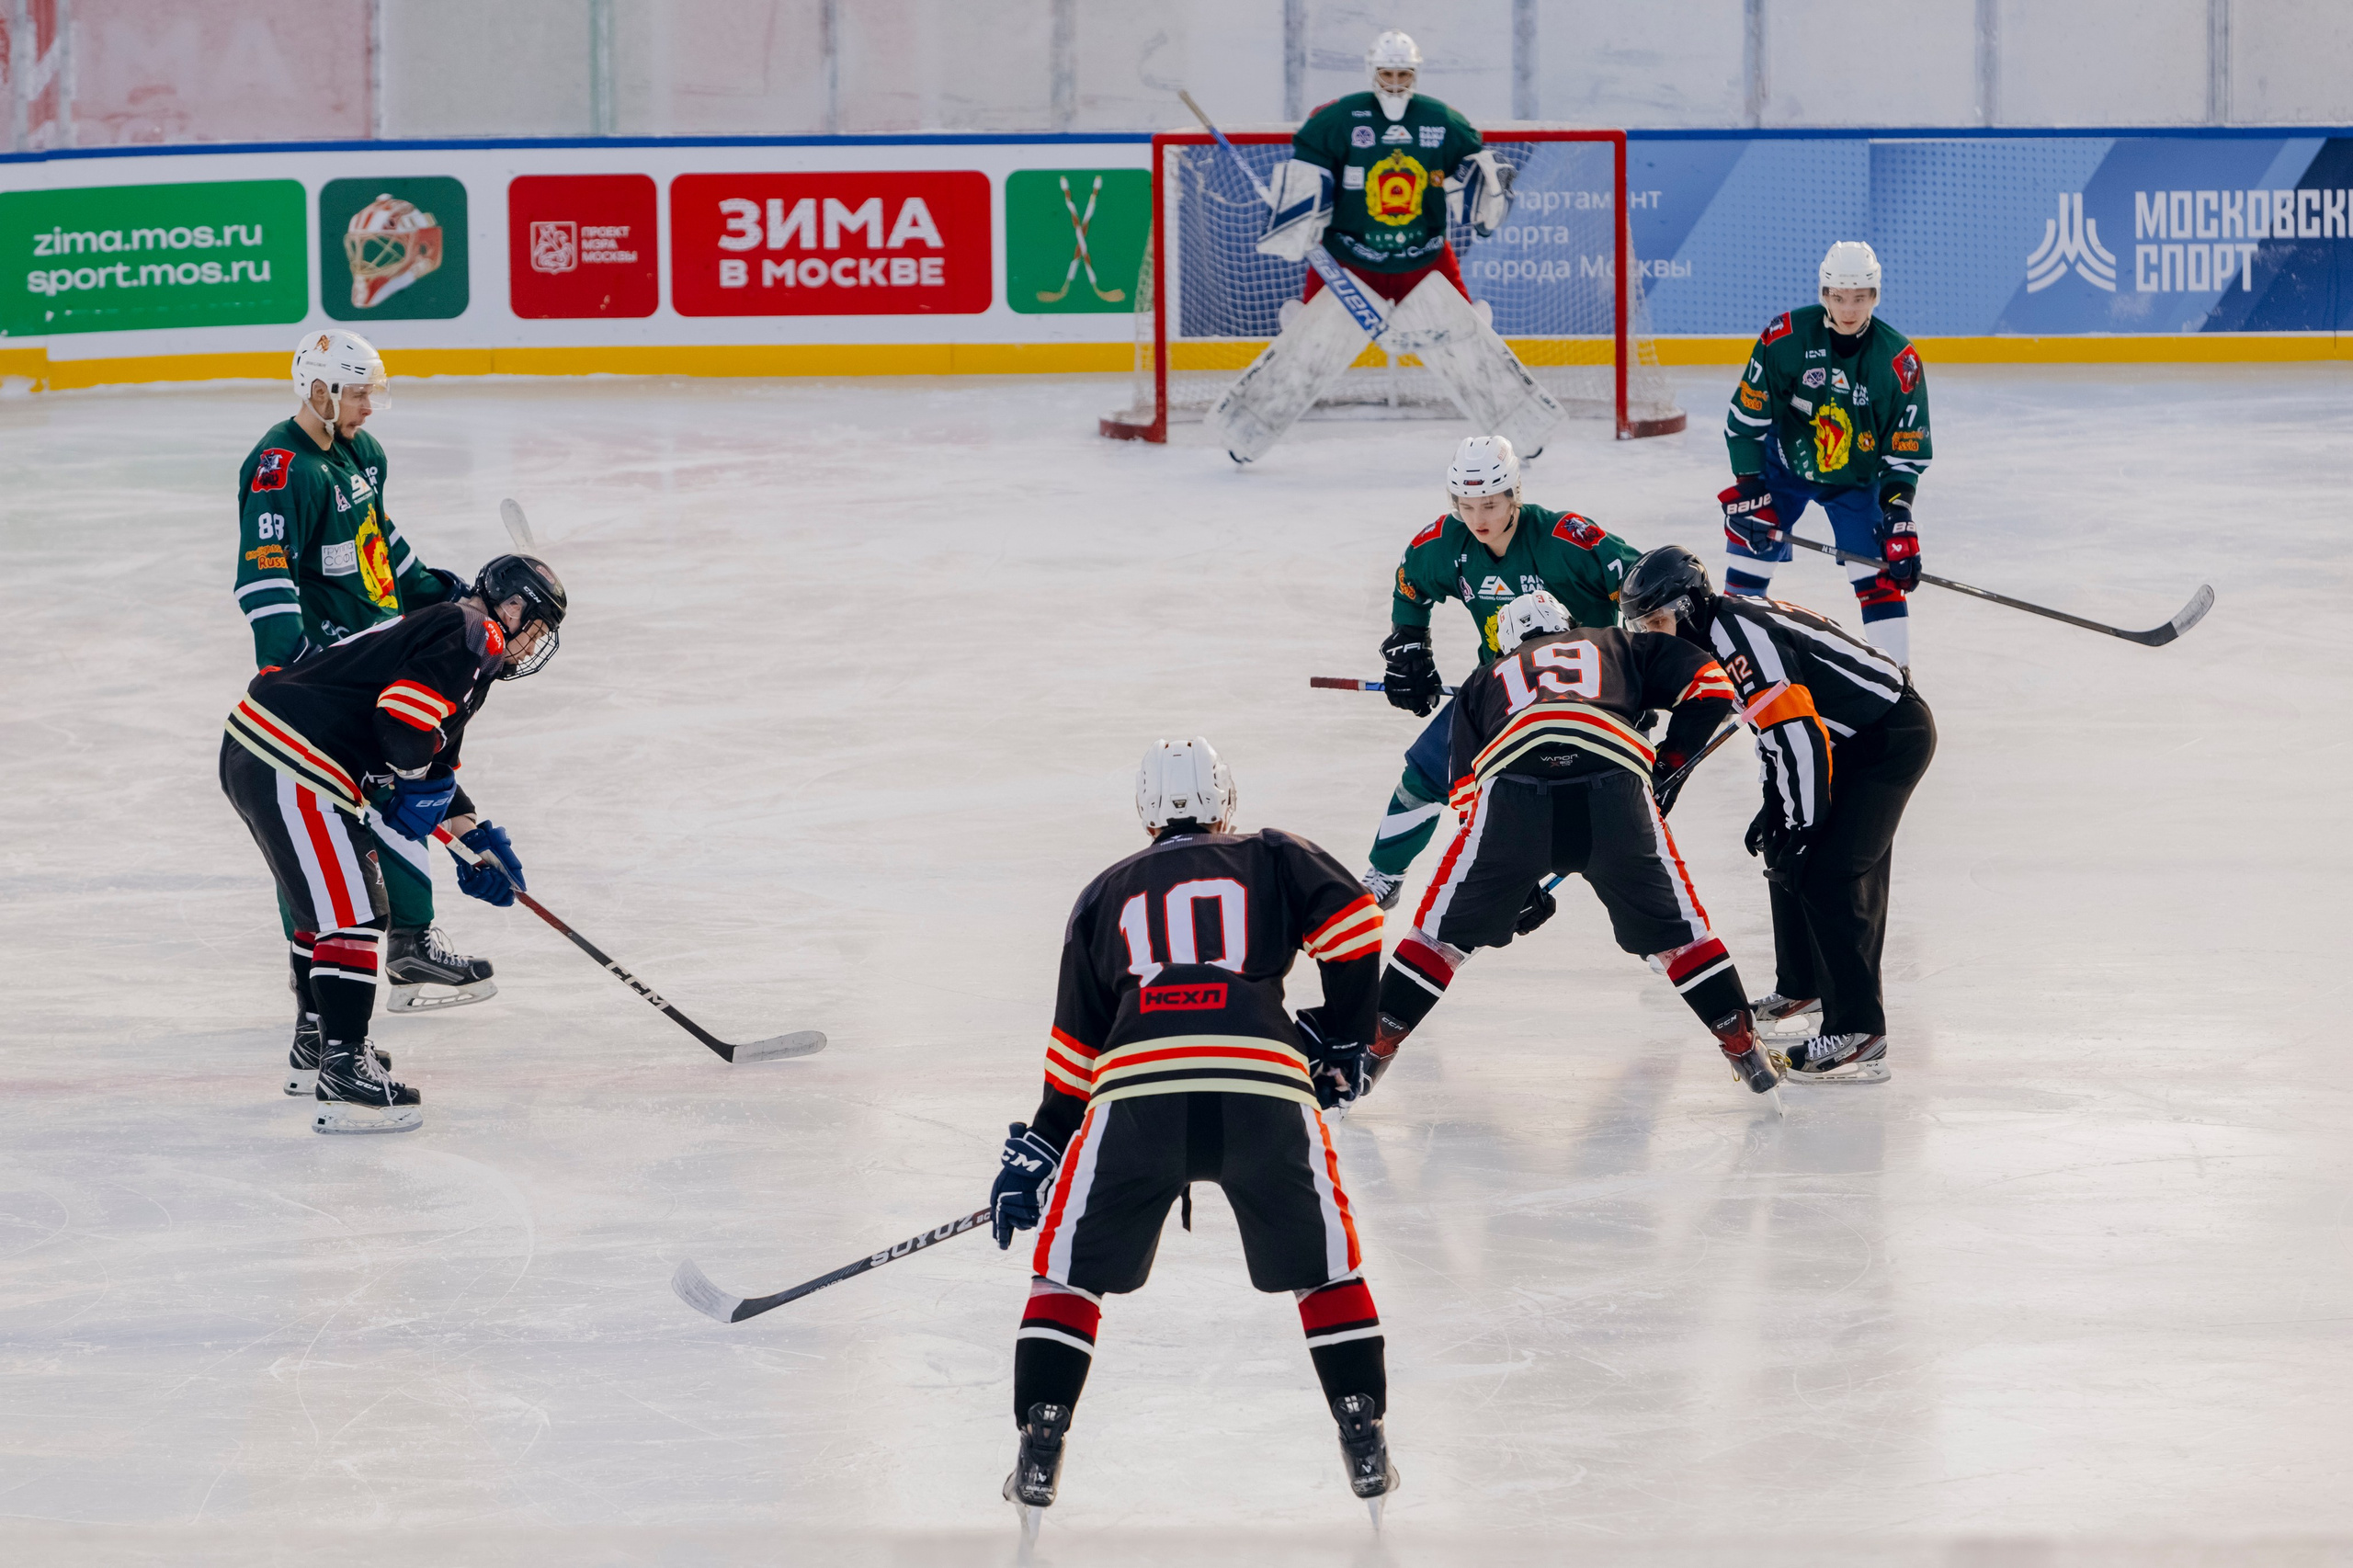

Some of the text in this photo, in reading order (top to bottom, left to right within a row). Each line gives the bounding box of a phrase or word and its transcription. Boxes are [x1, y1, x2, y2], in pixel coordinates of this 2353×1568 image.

[581, 225, 631, 238] ПРОЕКТ
[717, 197, 945, 251] ЗИМА
[33, 224, 263, 256] zima.mos.ru
[581, 238, 619, 250] МЭРА
[581, 250, 638, 264] МОСКВЫ
[1472, 255, 1692, 285] города Моквы
[2136, 243, 2258, 292] СПОРТ
[27, 260, 271, 297] sport.mos.ru
[719, 256, 945, 289] В МОСКВЕ
[258, 512, 285, 540] 88
[324, 542, 354, 555] группа
[324, 552, 355, 567] СОФТ
[523, 585, 542, 604] CCM
[1493, 639, 1602, 716] 19
[1725, 654, 1754, 685] 72
[1539, 754, 1579, 762] VAPOR
[1119, 877, 1248, 987] 10
[606, 961, 670, 1010] CCM
[1145, 990, 1221, 1006] НСХЛ
[1381, 1017, 1404, 1030] CCM
[1716, 1014, 1737, 1029] CCM
[355, 1080, 382, 1092] CCM
[870, 1213, 973, 1267] SOYUZ
